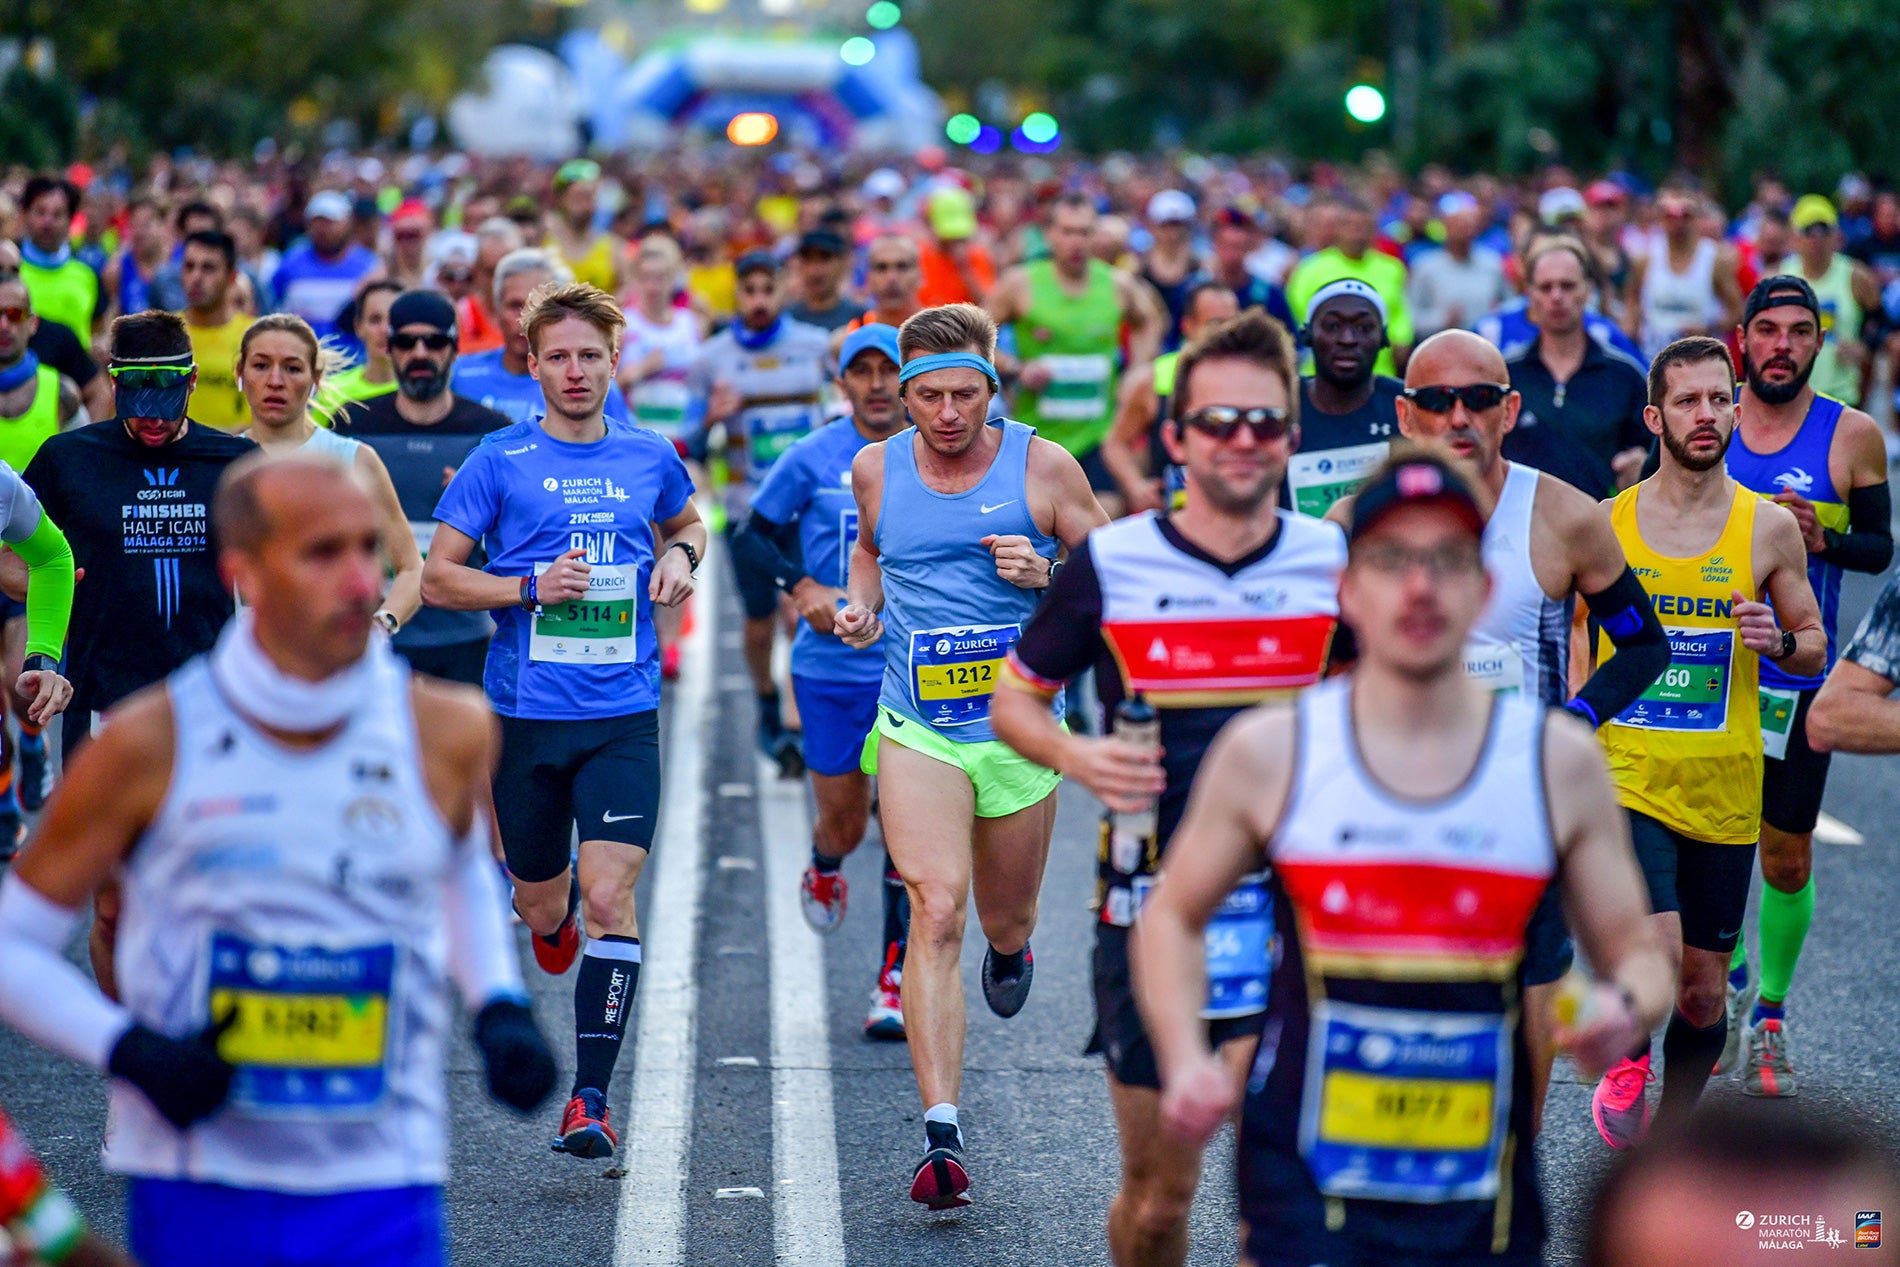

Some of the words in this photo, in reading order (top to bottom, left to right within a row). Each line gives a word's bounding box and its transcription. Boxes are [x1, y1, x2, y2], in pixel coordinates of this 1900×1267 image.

[562, 478, 601, 487] ZURICH
[563, 487, 603, 496] MARATÓN
[564, 495, 599, 504] MÁLAGA
[122, 504, 206, 518] FINISHER
[569, 513, 591, 524] 21K
[123, 521, 164, 534] HALF
[169, 520, 206, 534] ICAN
[124, 534, 174, 547] MÁLAGA
[177, 536, 206, 546] 2014
[570, 532, 616, 563] RUN
[1631, 568, 1652, 577] AFT
[1700, 566, 1733, 575] SVENSKA
[589, 577, 626, 587] ZURICH
[1702, 575, 1729, 583] LÖPARE
[1650, 594, 1733, 618] EDEN
[567, 605, 611, 622] 5114
[954, 638, 997, 650] ZURICH
[1669, 641, 1707, 652] URICH
[1462, 660, 1503, 672] RICH
[945, 665, 992, 684] 1212
